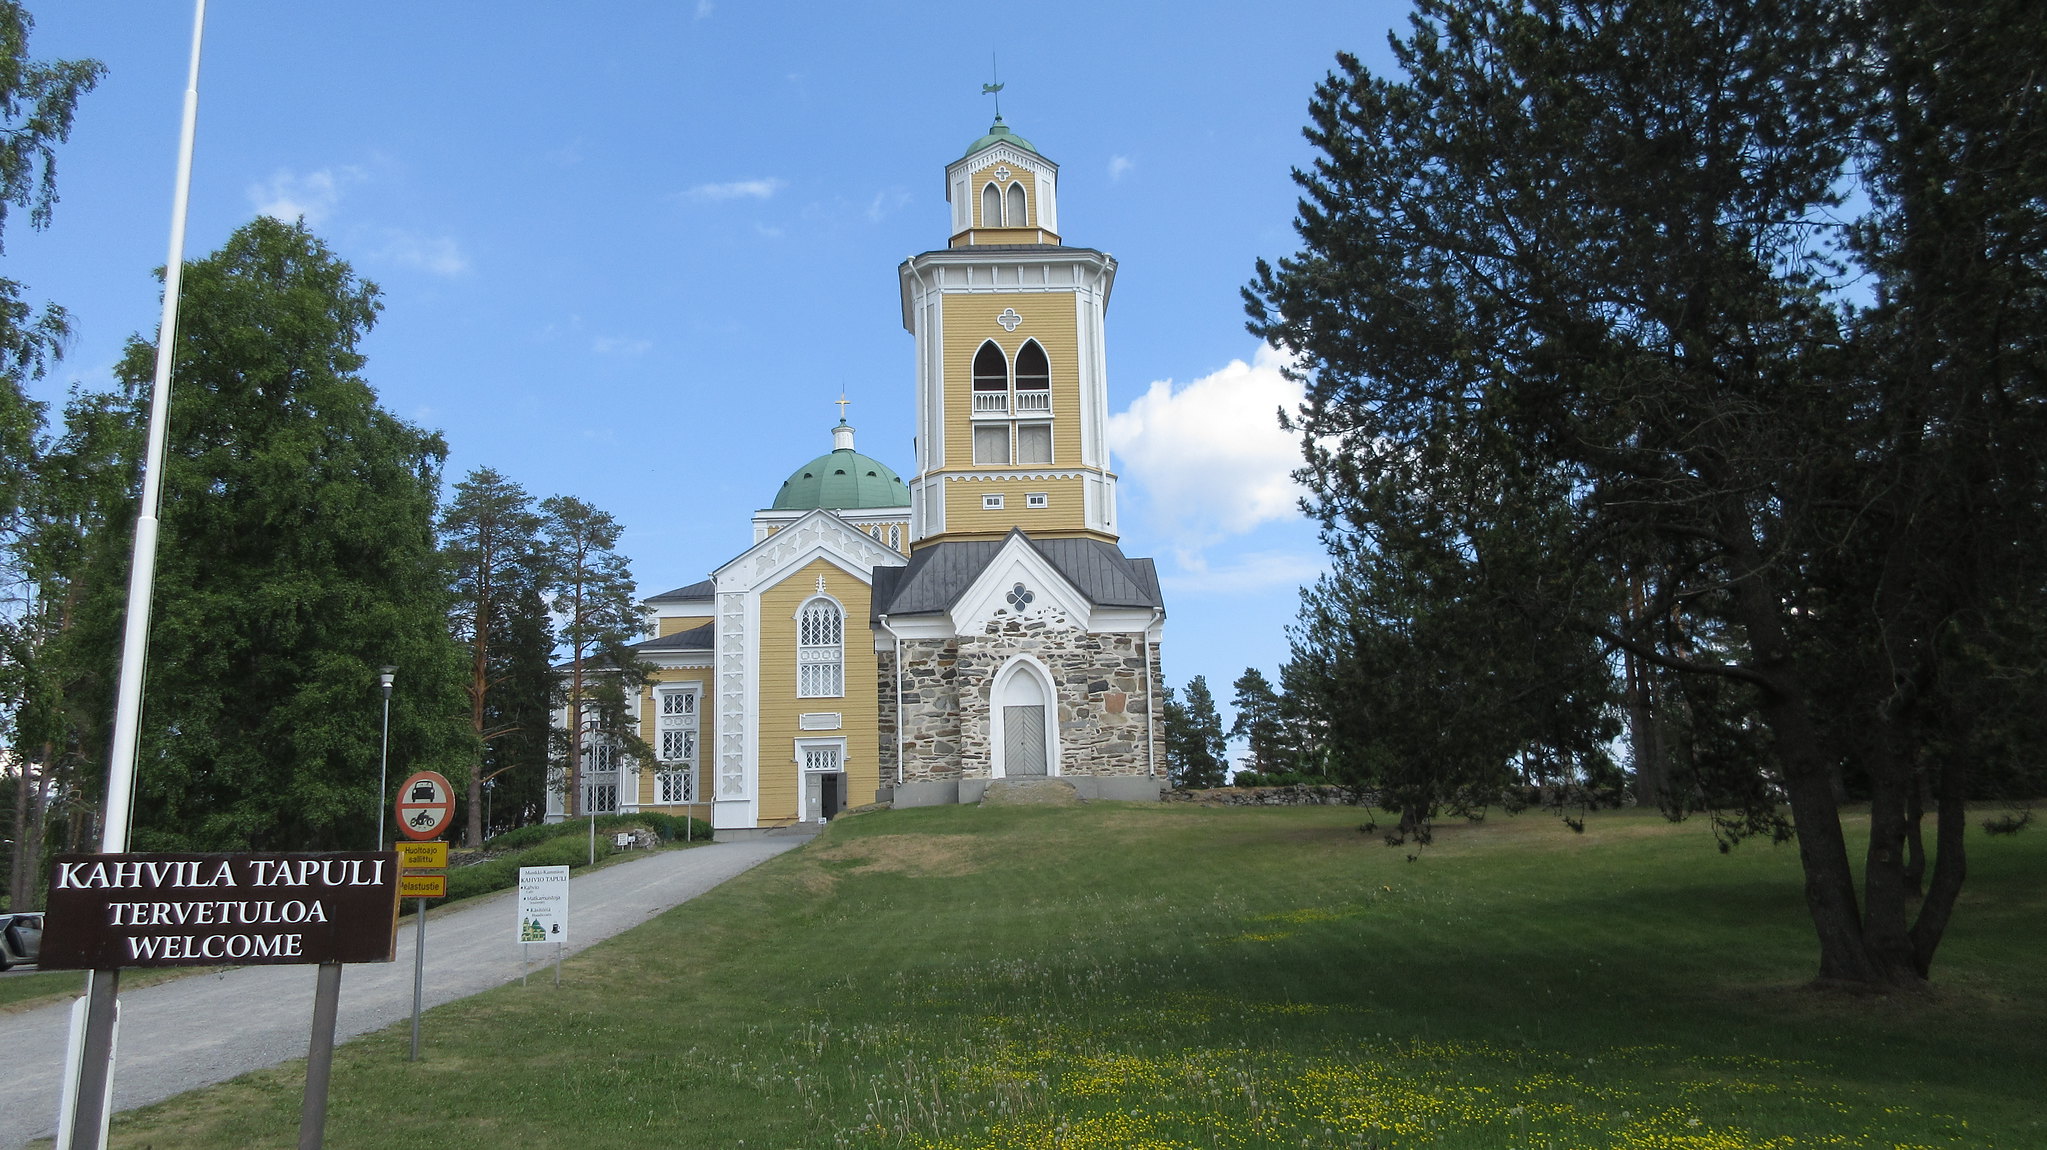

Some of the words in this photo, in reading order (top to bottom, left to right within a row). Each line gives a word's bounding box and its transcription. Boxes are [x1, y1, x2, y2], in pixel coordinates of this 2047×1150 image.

[405, 847, 437, 855] Huoltoajo
[56, 860, 238, 889] KAHVILA
[248, 859, 386, 886] TAPULI
[108, 900, 329, 926] TERVETULOA
[127, 933, 304, 960] WELCOME
